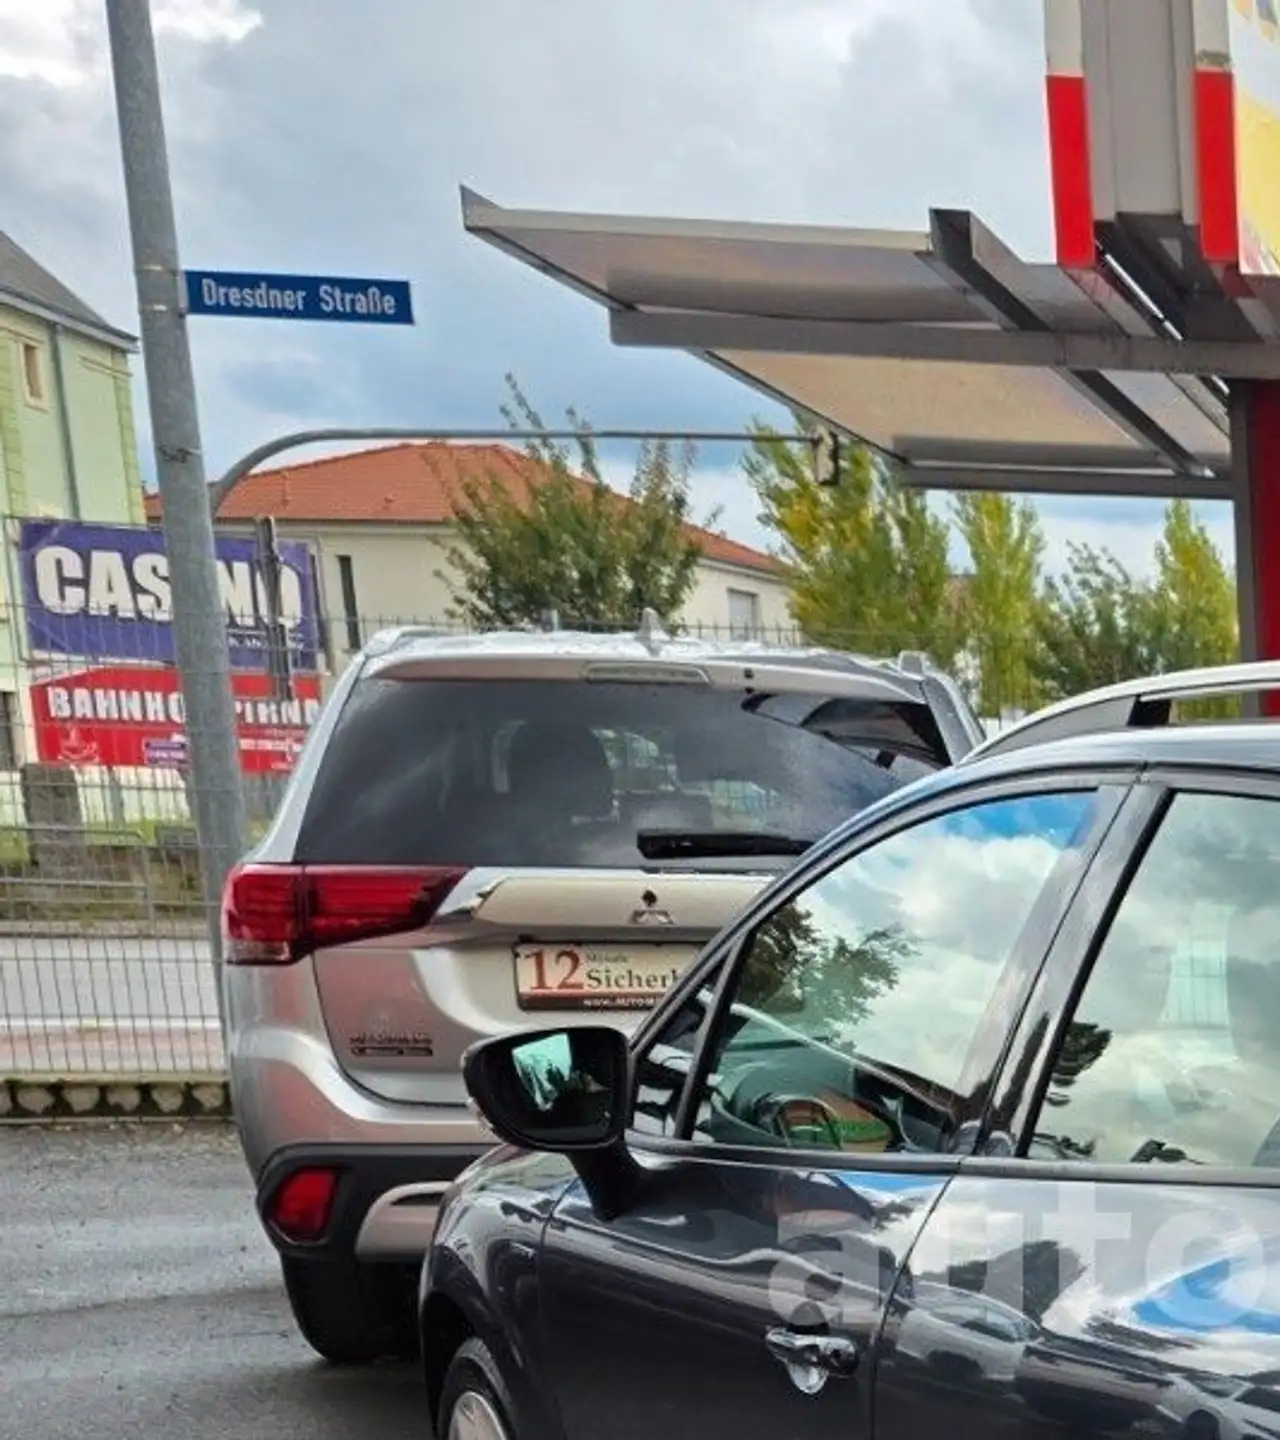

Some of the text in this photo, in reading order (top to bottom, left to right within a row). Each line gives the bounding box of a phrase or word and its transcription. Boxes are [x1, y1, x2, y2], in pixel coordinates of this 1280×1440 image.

[201, 278, 397, 315] Dresdner Straße
[34, 545, 303, 629] CASNO
[526, 950, 585, 991] 12
